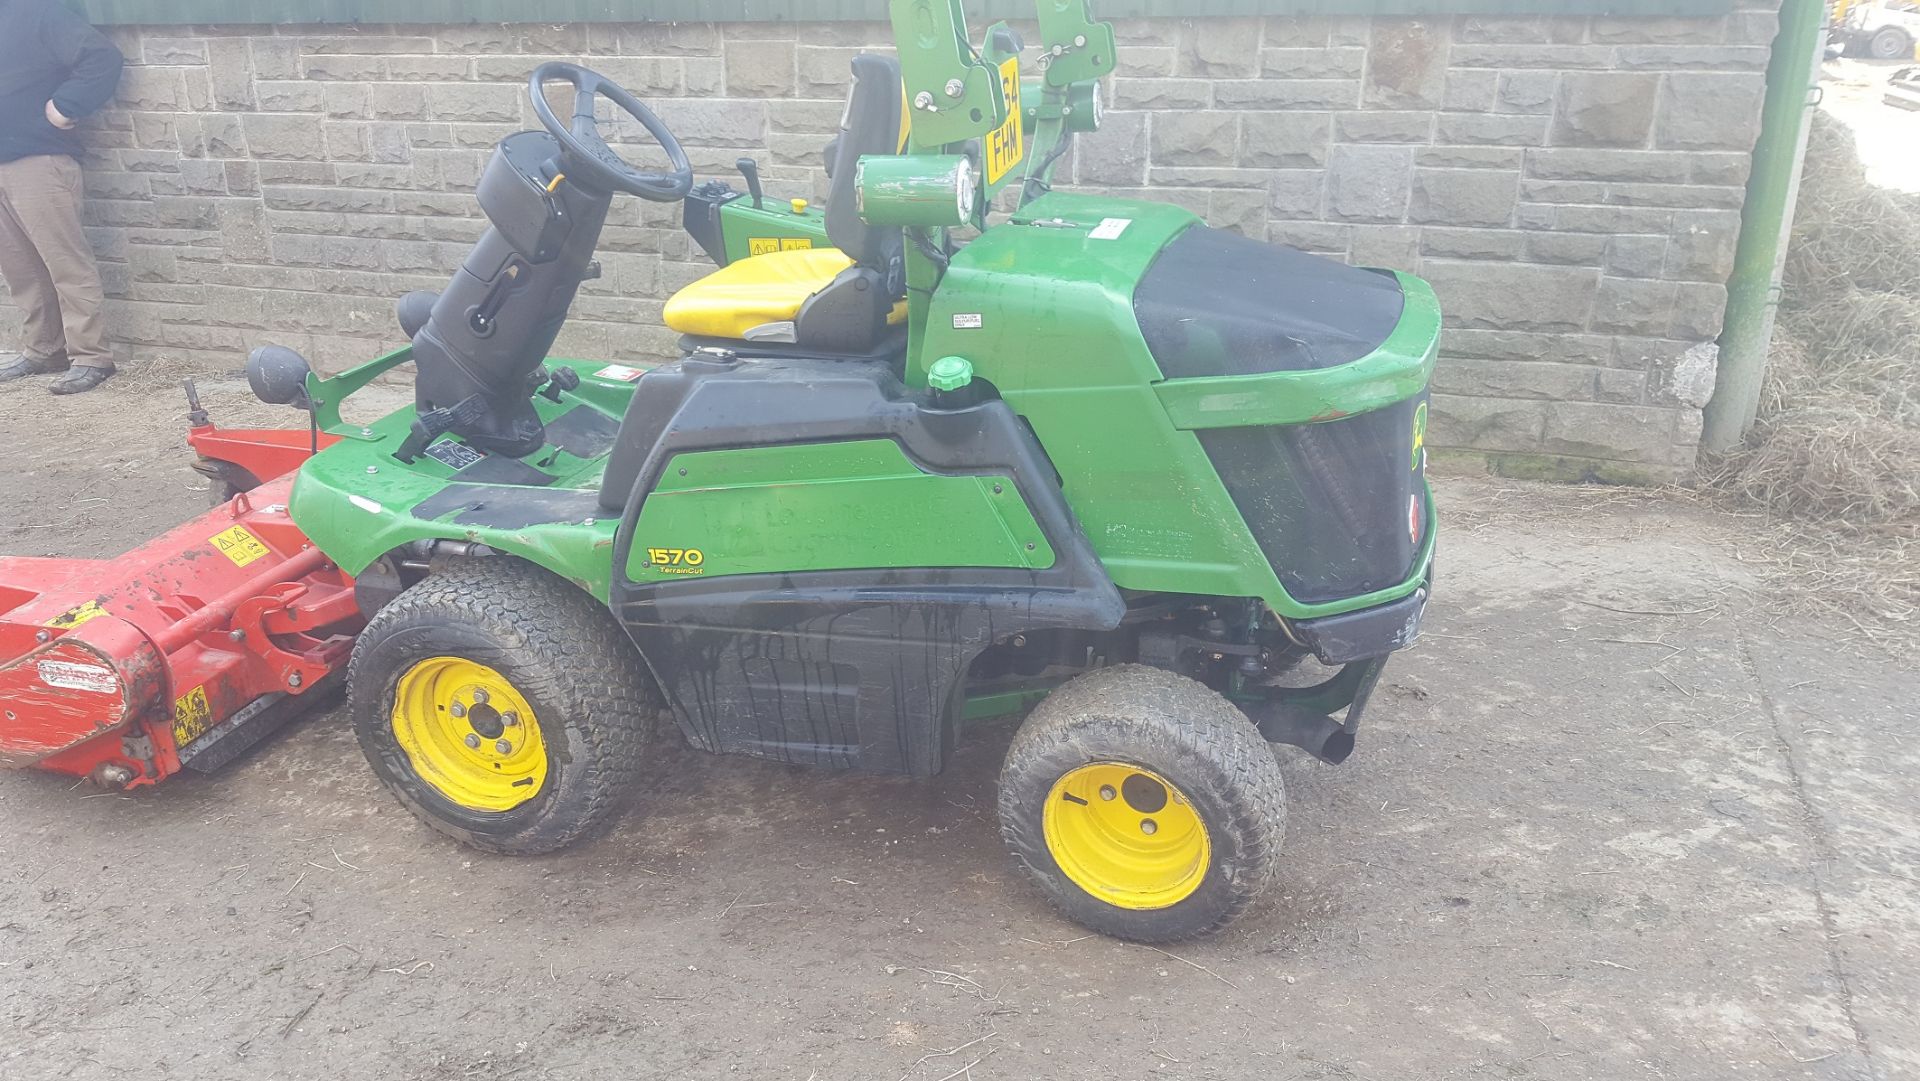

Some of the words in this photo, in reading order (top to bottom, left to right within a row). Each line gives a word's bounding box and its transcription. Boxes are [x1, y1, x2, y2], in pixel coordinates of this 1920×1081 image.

[993, 118, 1018, 174] FHM
[647, 547, 704, 566] 1570
[659, 566, 704, 575] TerrainCut
